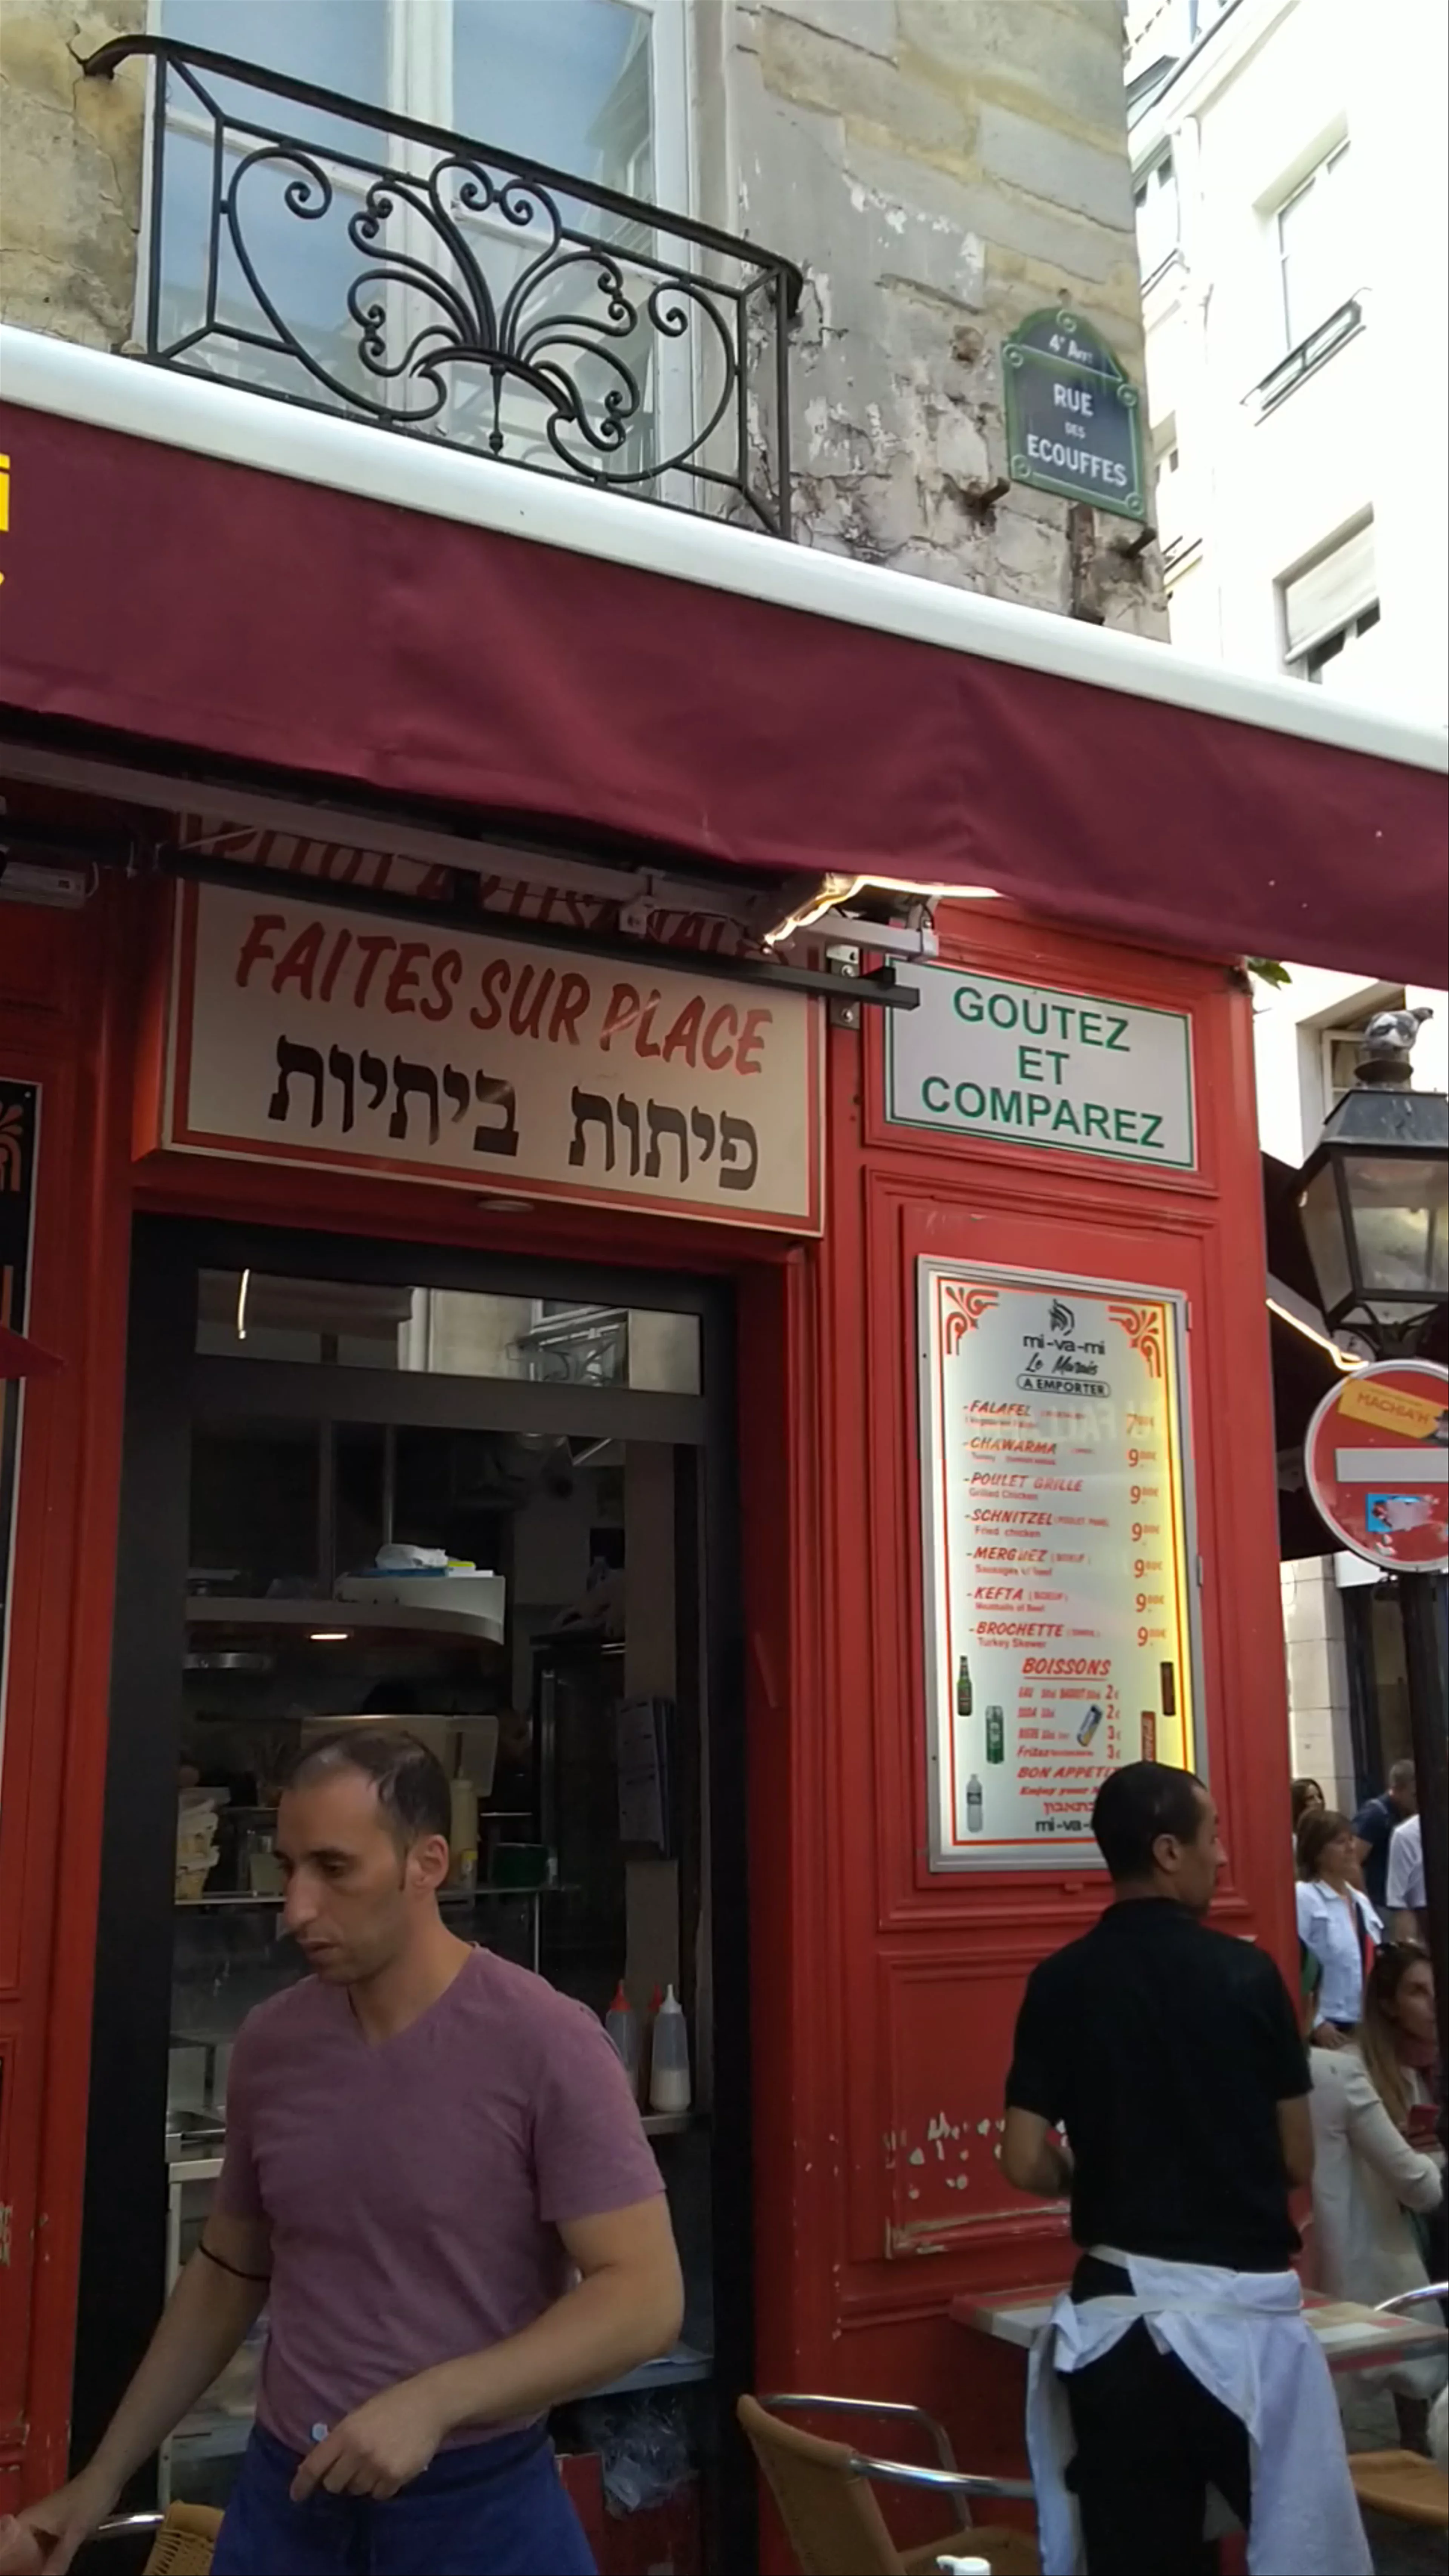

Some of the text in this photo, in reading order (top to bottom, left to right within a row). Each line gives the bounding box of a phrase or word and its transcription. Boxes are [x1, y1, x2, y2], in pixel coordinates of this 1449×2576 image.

[1053, 383, 1094, 416] RUE
[1064, 421, 1086, 439] DES
[1027, 434, 1128, 486] ECOUFFES
[235, 914, 773, 1075] FAITES SUR PLACE
[953, 986, 1131, 1052] GOUTEZ
[1018, 1045, 1070, 1085] ET
[268, 1033, 759, 1191] פיתות ביתיות
[921, 1076, 1165, 1149] COMPAREZ
[1023, 1333, 1105, 1355] mi-va-mi
[1024, 1378, 1104, 1394] A EMPORTER
[1022, 1657, 1111, 1676] BOISSONS
[1017, 1766, 1052, 1779] BON
[1035, 1816, 1091, 1832] mi-va-
